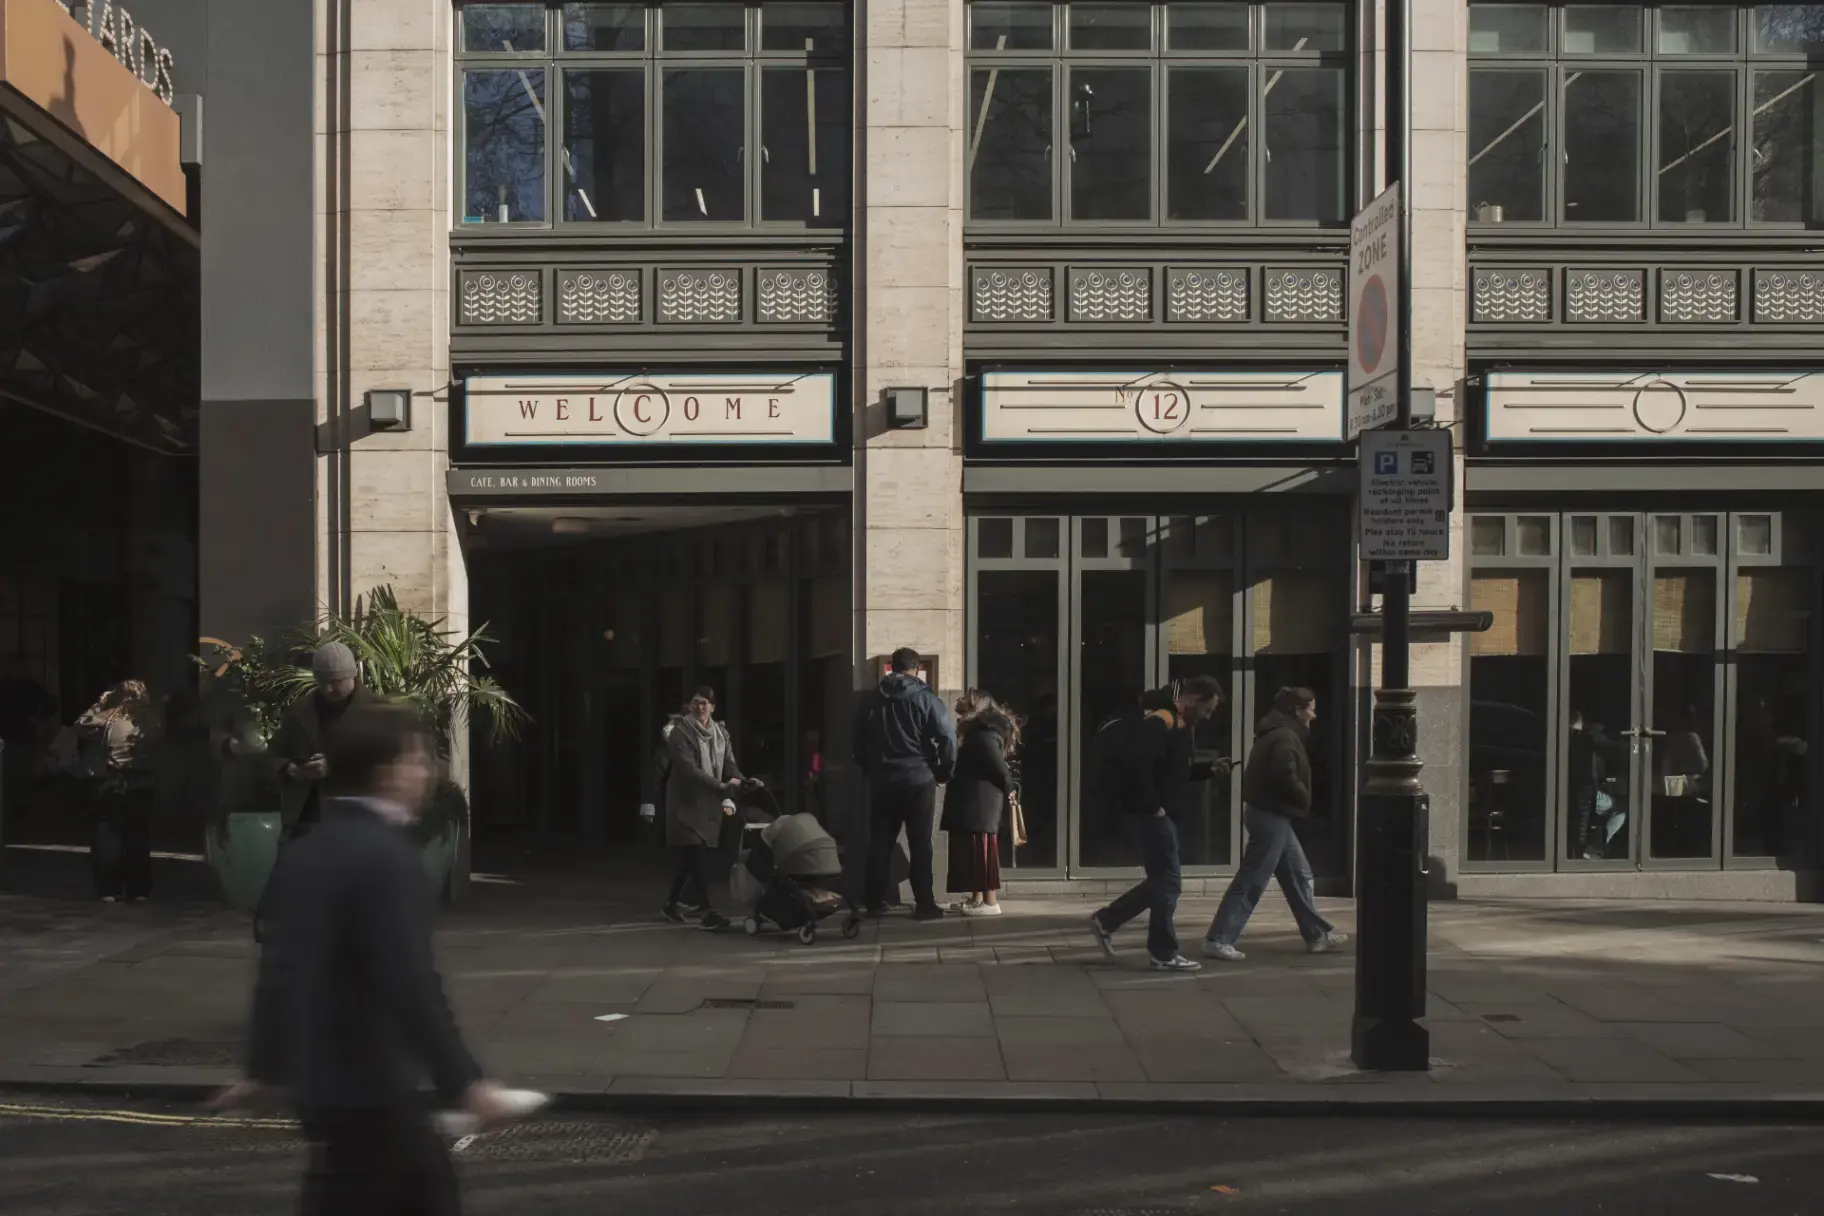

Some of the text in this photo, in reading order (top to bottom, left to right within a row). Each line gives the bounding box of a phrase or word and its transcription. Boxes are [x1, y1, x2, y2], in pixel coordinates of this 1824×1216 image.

[1353, 198, 1395, 246] Controlled
[1358, 231, 1388, 274] ZONE
[519, 395, 780, 423] WELCOME
[1153, 393, 1178, 419] 12
[1380, 455, 1395, 473] P
[500, 476, 518, 487] BAR
[522, 479, 528, 487] &
[531, 476, 561, 487] DINING
[566, 476, 597, 487] ROOMS
[1417, 487, 1441, 497] point
[1405, 496, 1429, 504] times
[1404, 508, 1434, 518] permit
[1365, 527, 1383, 536] Max
[1385, 527, 1404, 537] stay
[1418, 527, 1445, 536] hours
[1383, 539, 1426, 548] No return
[1369, 548, 1396, 557] within
[1423, 548, 1439, 558] day
